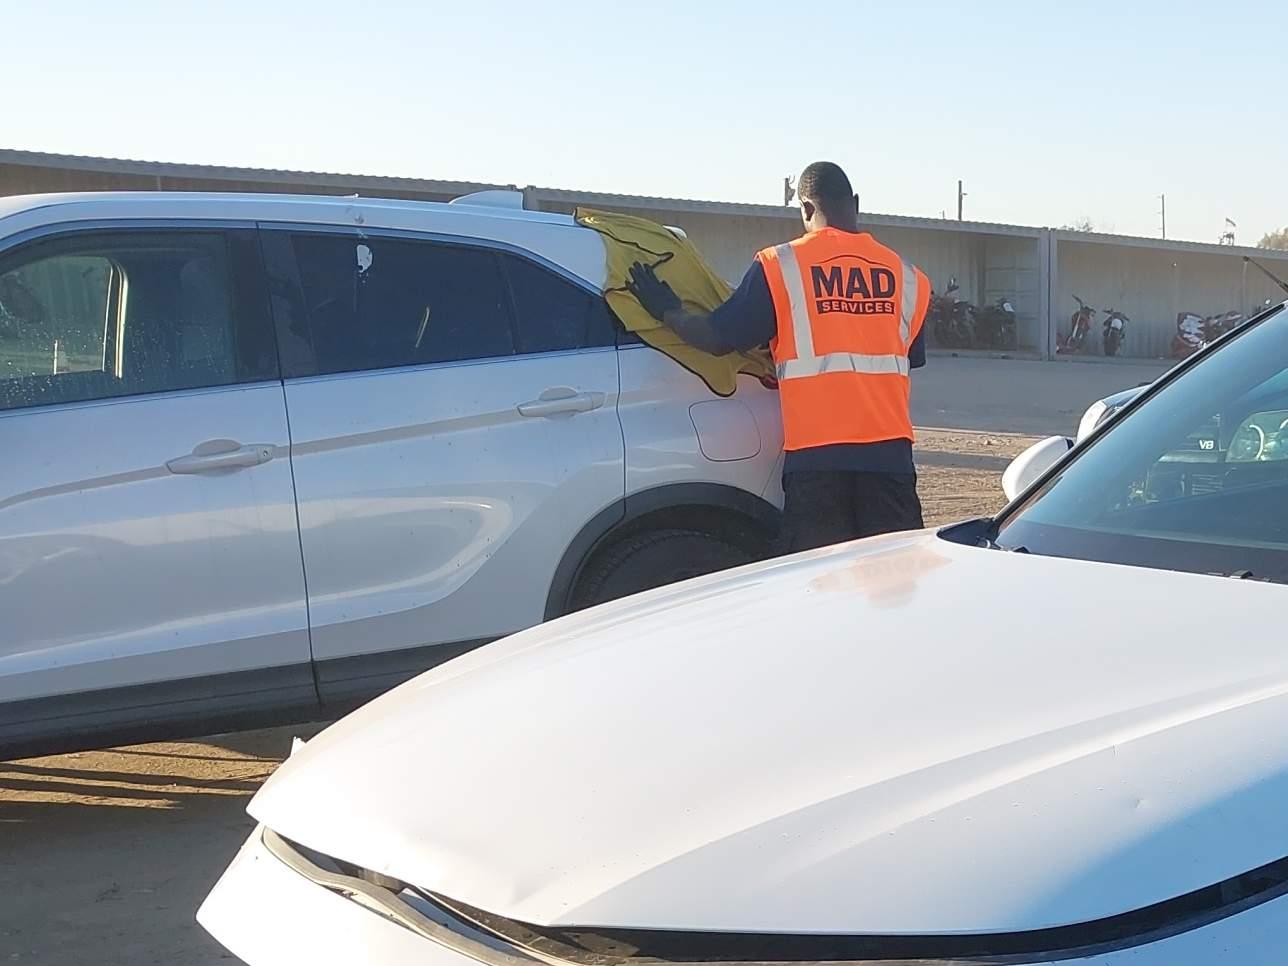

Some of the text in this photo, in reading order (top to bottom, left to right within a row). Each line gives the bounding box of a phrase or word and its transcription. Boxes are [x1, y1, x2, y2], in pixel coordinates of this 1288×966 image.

[810, 266, 896, 299] MAD
[822, 301, 893, 313] SERVICES
[1199, 439, 1214, 450] V8
